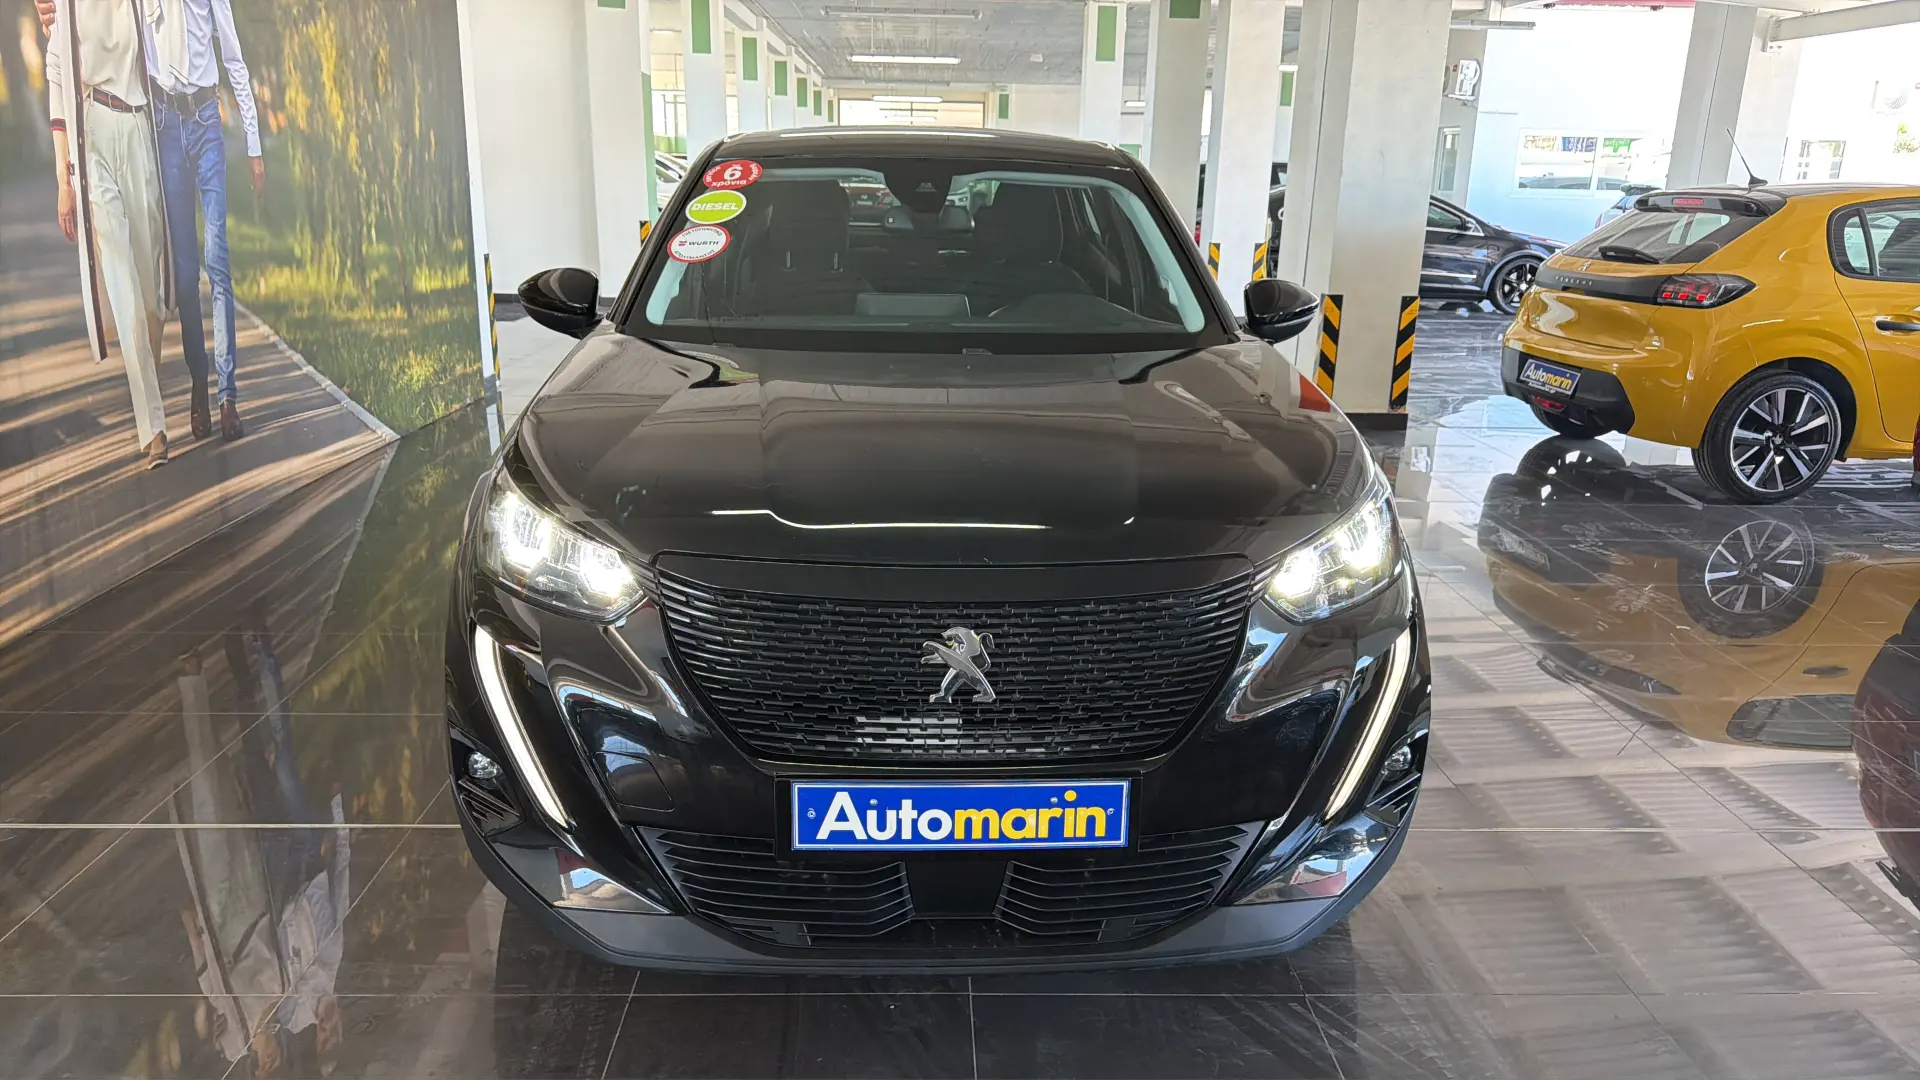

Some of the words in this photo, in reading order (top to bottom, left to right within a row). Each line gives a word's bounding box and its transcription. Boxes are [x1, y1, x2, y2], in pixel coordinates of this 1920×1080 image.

[723, 166, 743, 180] 6
[691, 203, 739, 211] DIESEL
[1524, 363, 1573, 390] Automarin
[815, 789, 1107, 841] Automarin
